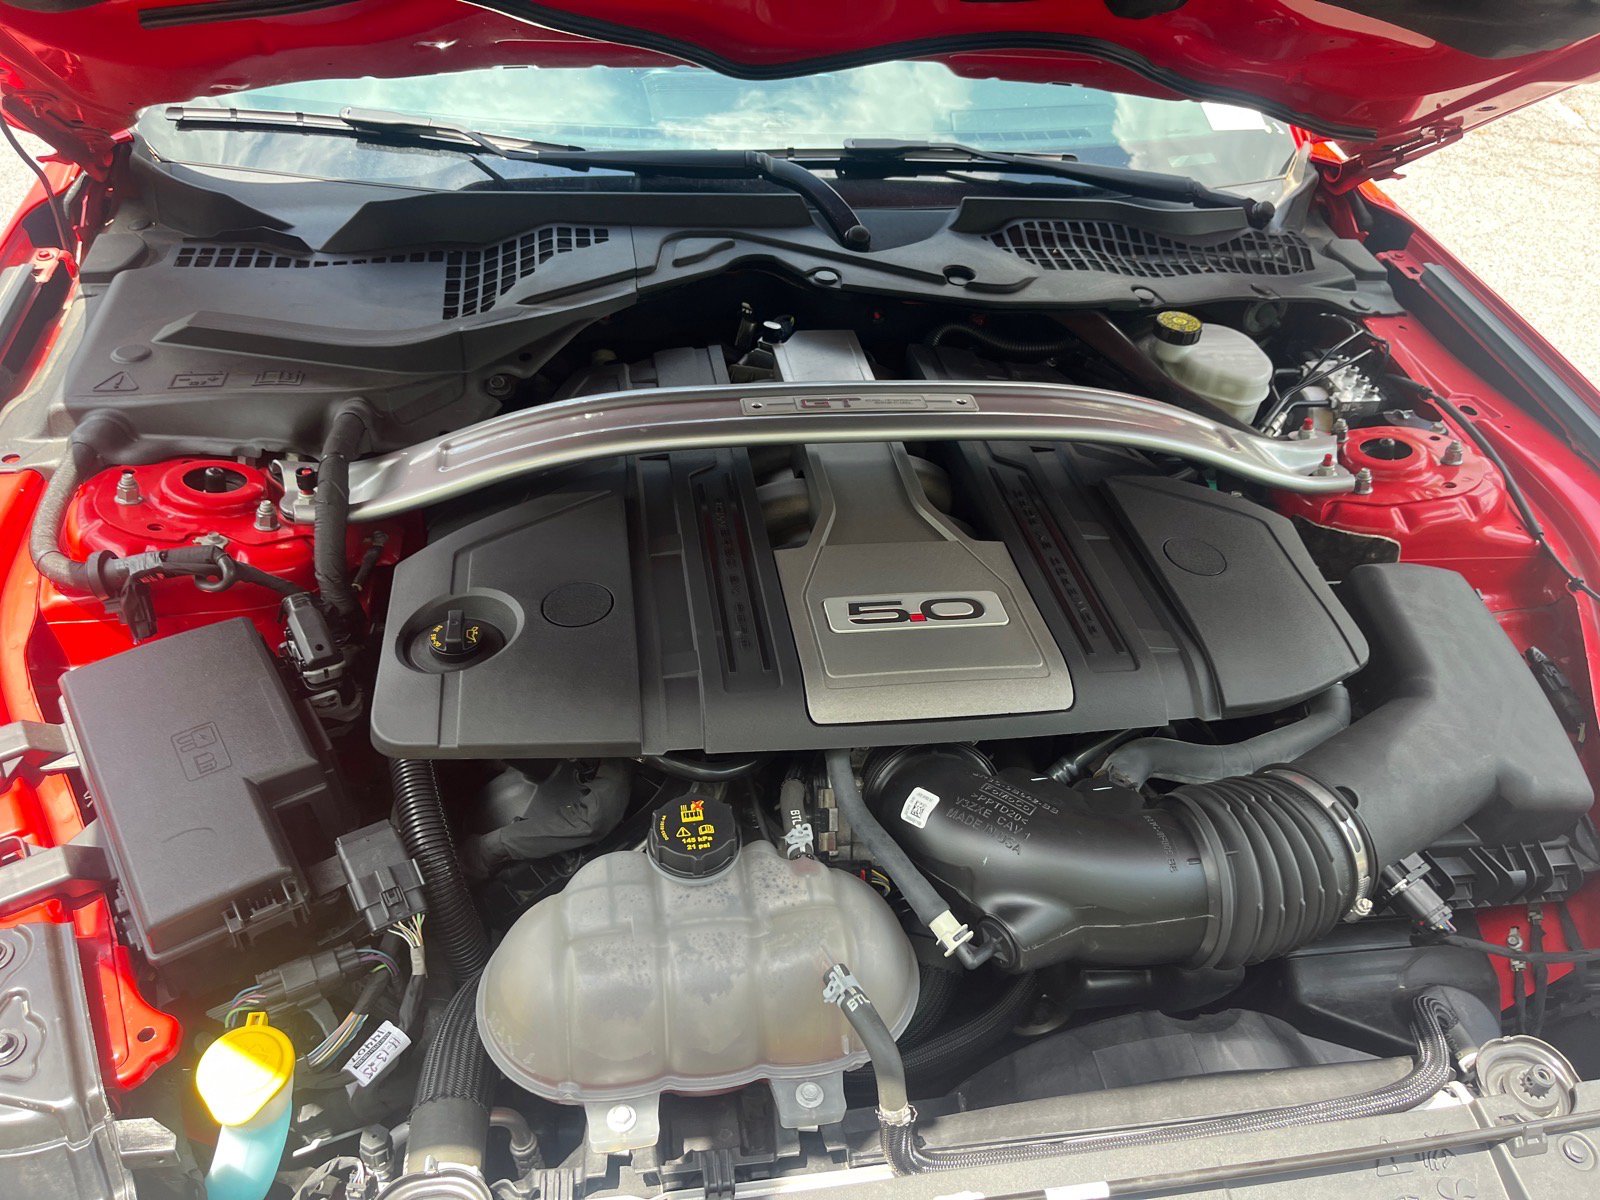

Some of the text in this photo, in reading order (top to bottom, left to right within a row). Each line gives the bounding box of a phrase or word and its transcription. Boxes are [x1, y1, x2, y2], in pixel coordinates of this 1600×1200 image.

[800, 397, 861, 409] GT
[847, 597, 986, 625] 5.0
[946, 808, 983, 830] MADE
[998, 831, 1021, 855] USA
[681, 836, 697, 844] 145
[698, 842, 711, 850] psi
